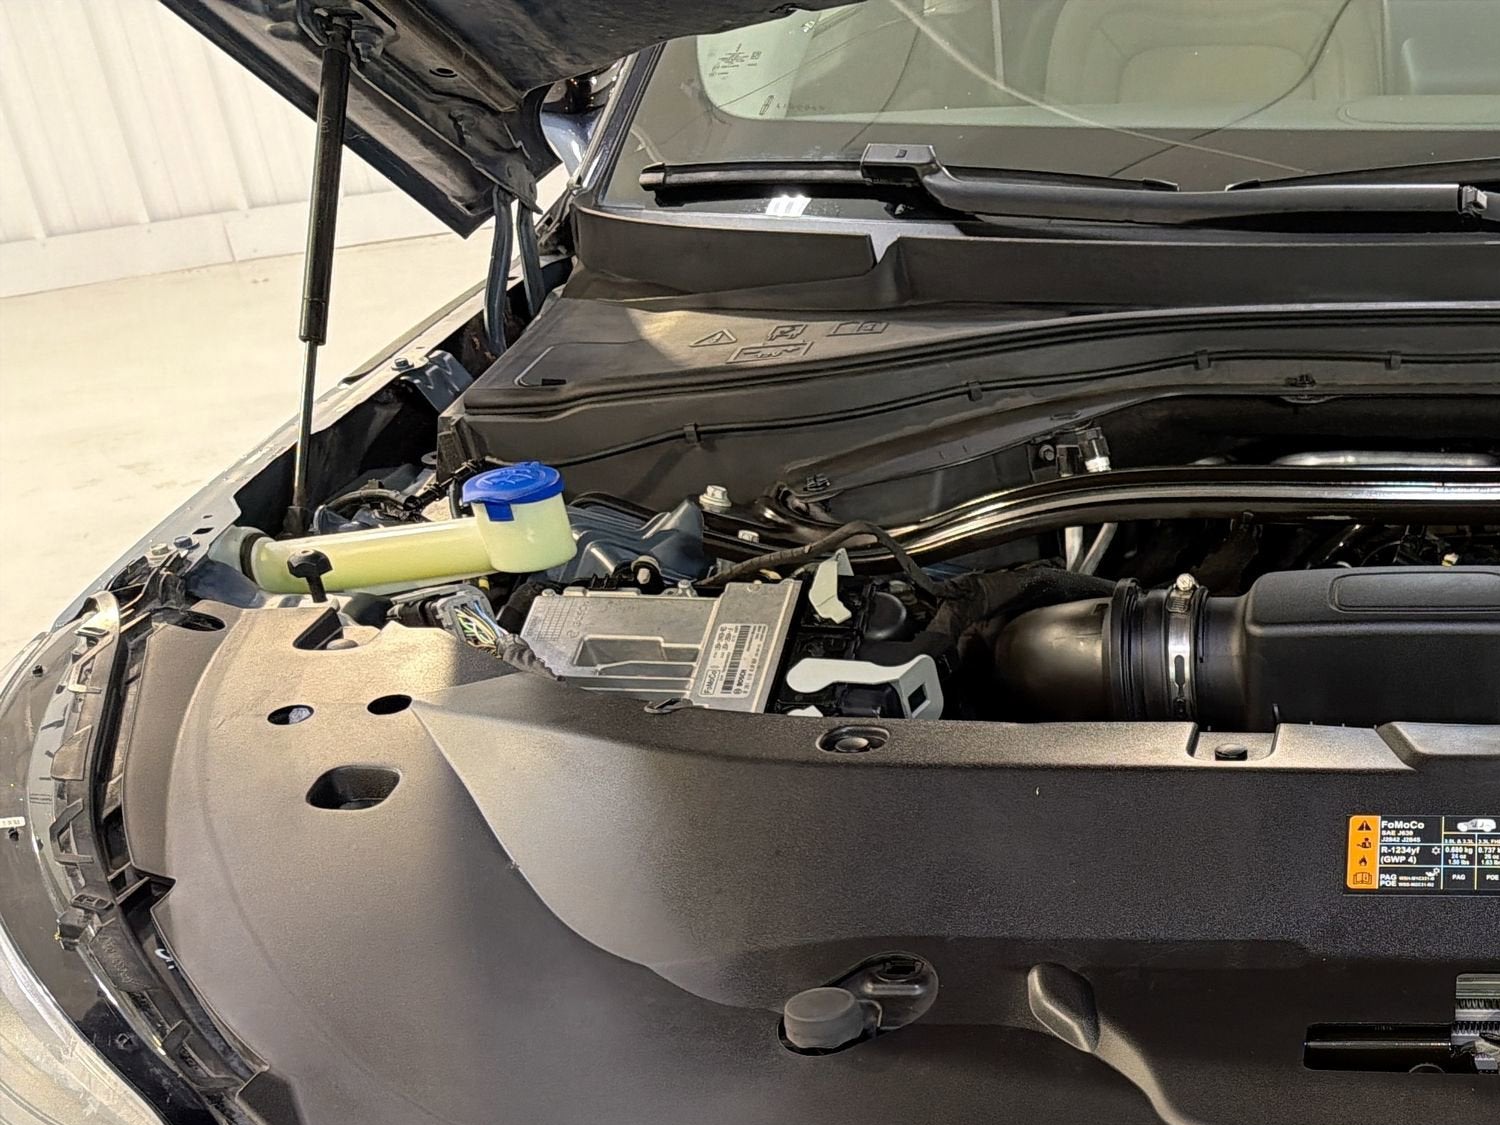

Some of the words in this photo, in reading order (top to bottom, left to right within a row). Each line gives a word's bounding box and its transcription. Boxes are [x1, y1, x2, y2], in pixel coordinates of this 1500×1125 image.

[1381, 820, 1425, 829] FoMoCo
[1381, 846, 1421, 855] R-1234yf
[1464, 847, 1473, 855] kg
[1380, 855, 1407, 864] (GWP
[1407, 855, 1417, 864] 4)
